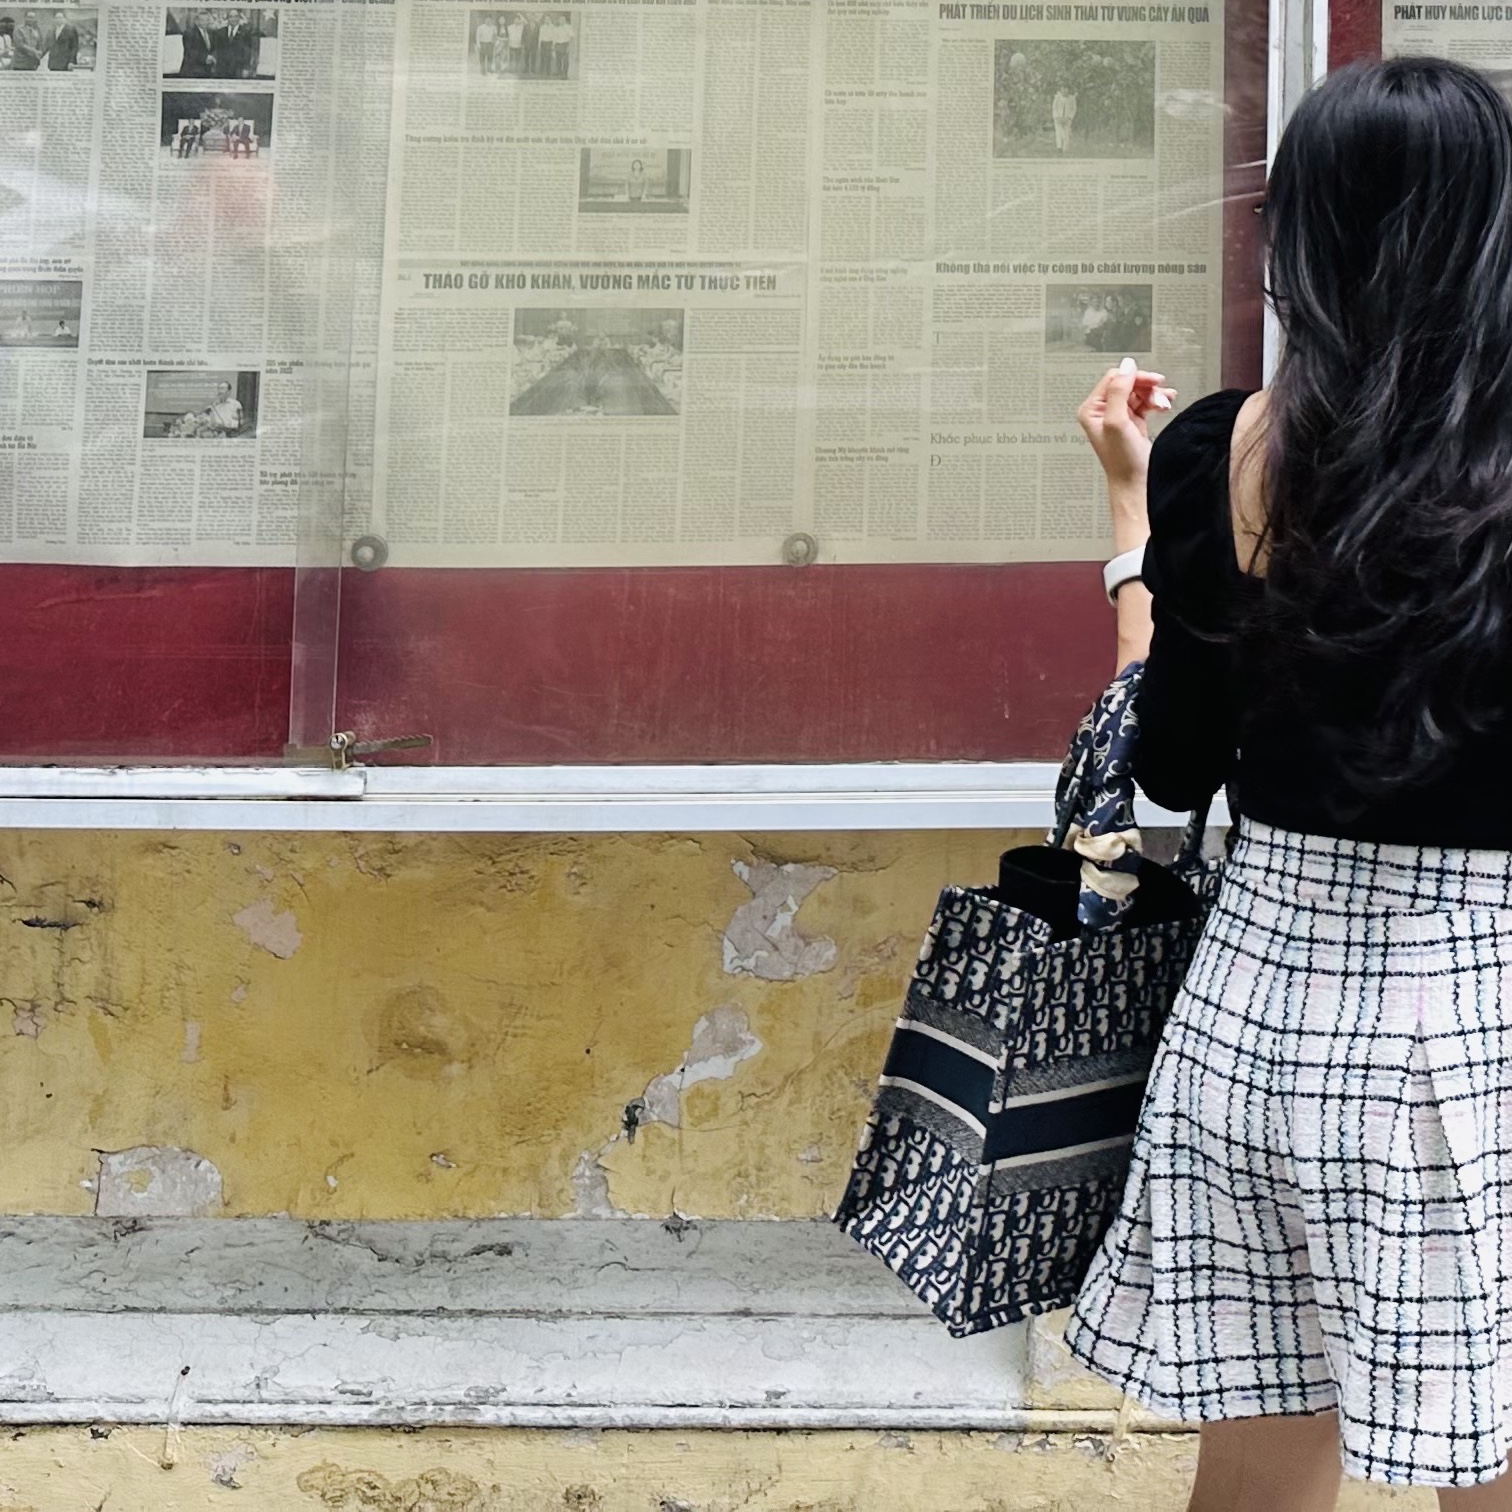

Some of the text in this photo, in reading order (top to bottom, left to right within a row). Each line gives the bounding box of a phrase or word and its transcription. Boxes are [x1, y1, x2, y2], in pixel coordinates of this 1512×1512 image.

[939, 1, 967, 19] PHÁT
[1002, 4, 1018, 20] DU
[1019, 4, 1043, 23] LỊCH
[1046, 4, 1071, 20] SINH
[1074, 2, 1098, 20] THÁI
[1394, 2, 1423, 19] PHÁT
[1425, 5, 1447, 20] HUY
[1450, 3, 1479, 20] NĂNG
[1482, 5, 1502, 23] LỰC
[936, 262, 970, 275] Không
